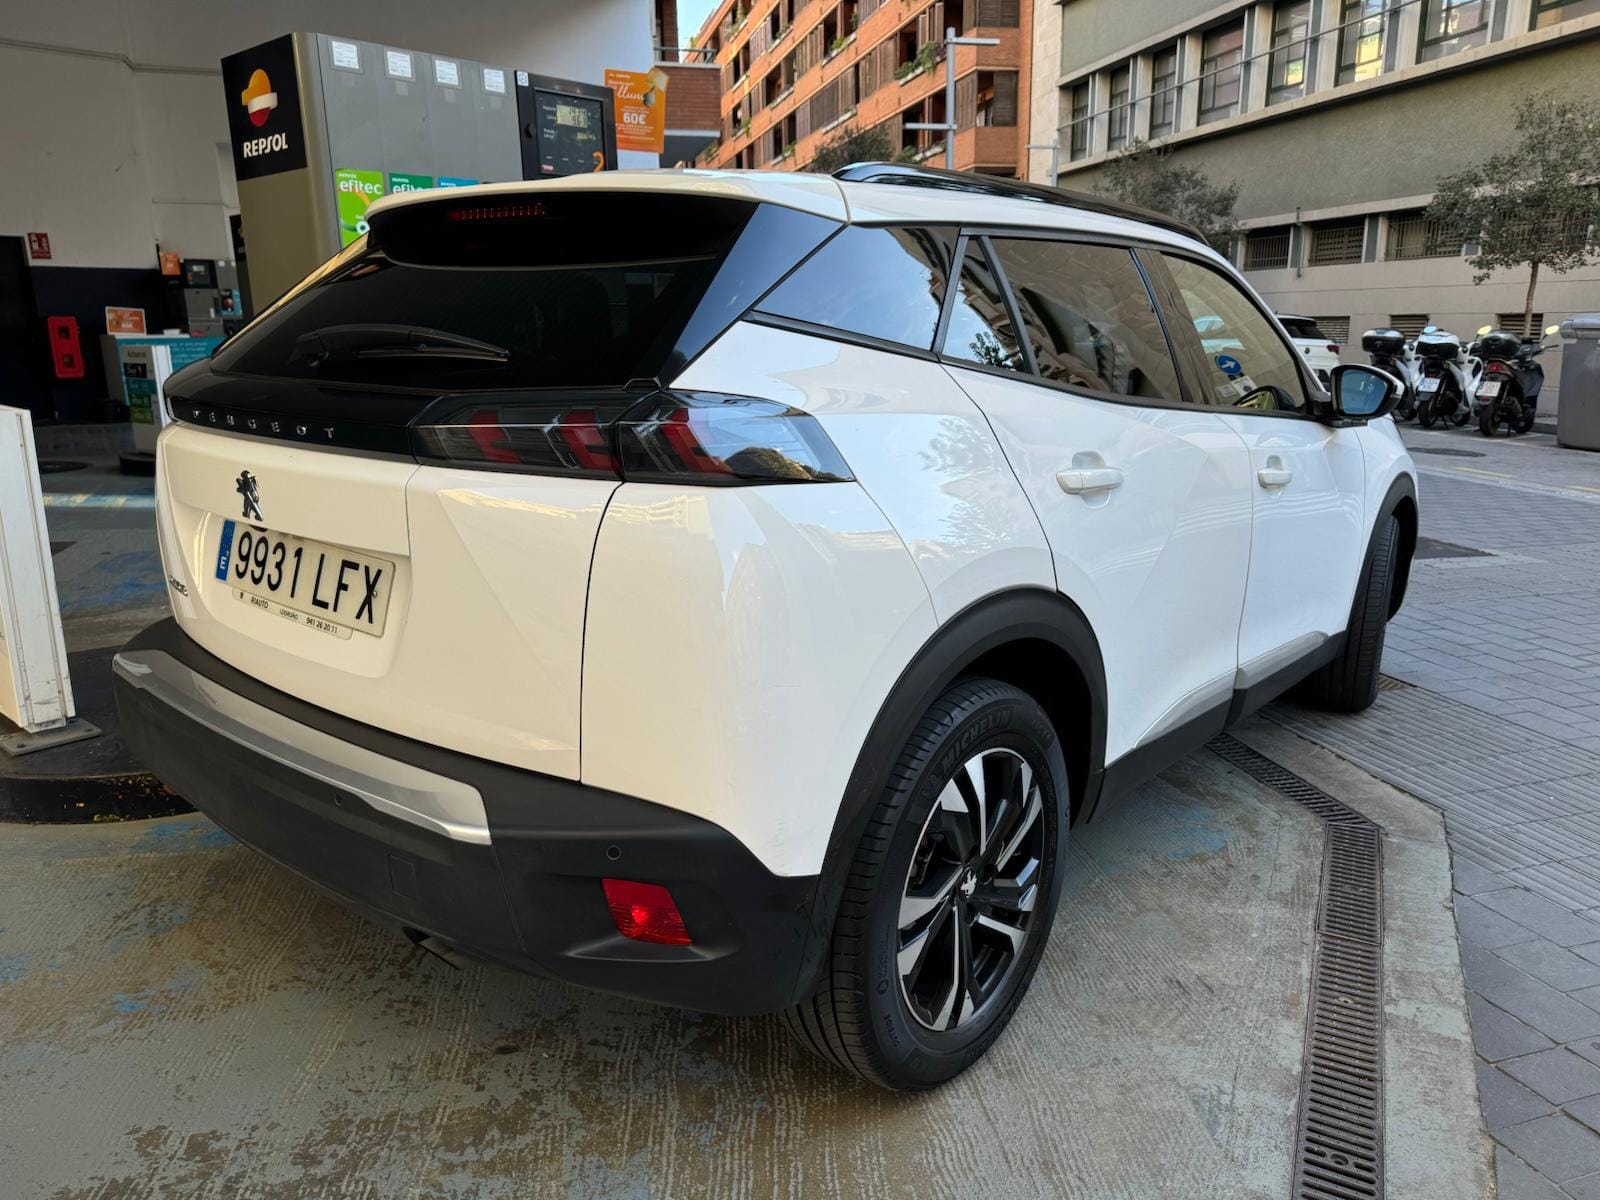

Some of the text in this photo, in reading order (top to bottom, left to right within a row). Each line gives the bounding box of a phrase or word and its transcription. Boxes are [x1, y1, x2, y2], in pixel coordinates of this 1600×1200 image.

[623, 112, 646, 124] 60€
[243, 132, 288, 158] REPSOL
[340, 178, 382, 195] efitec
[193, 409, 335, 439] PEUGEOT
[235, 531, 382, 624] 9931 LFX
[942, 709, 1013, 773] MICHELIN
